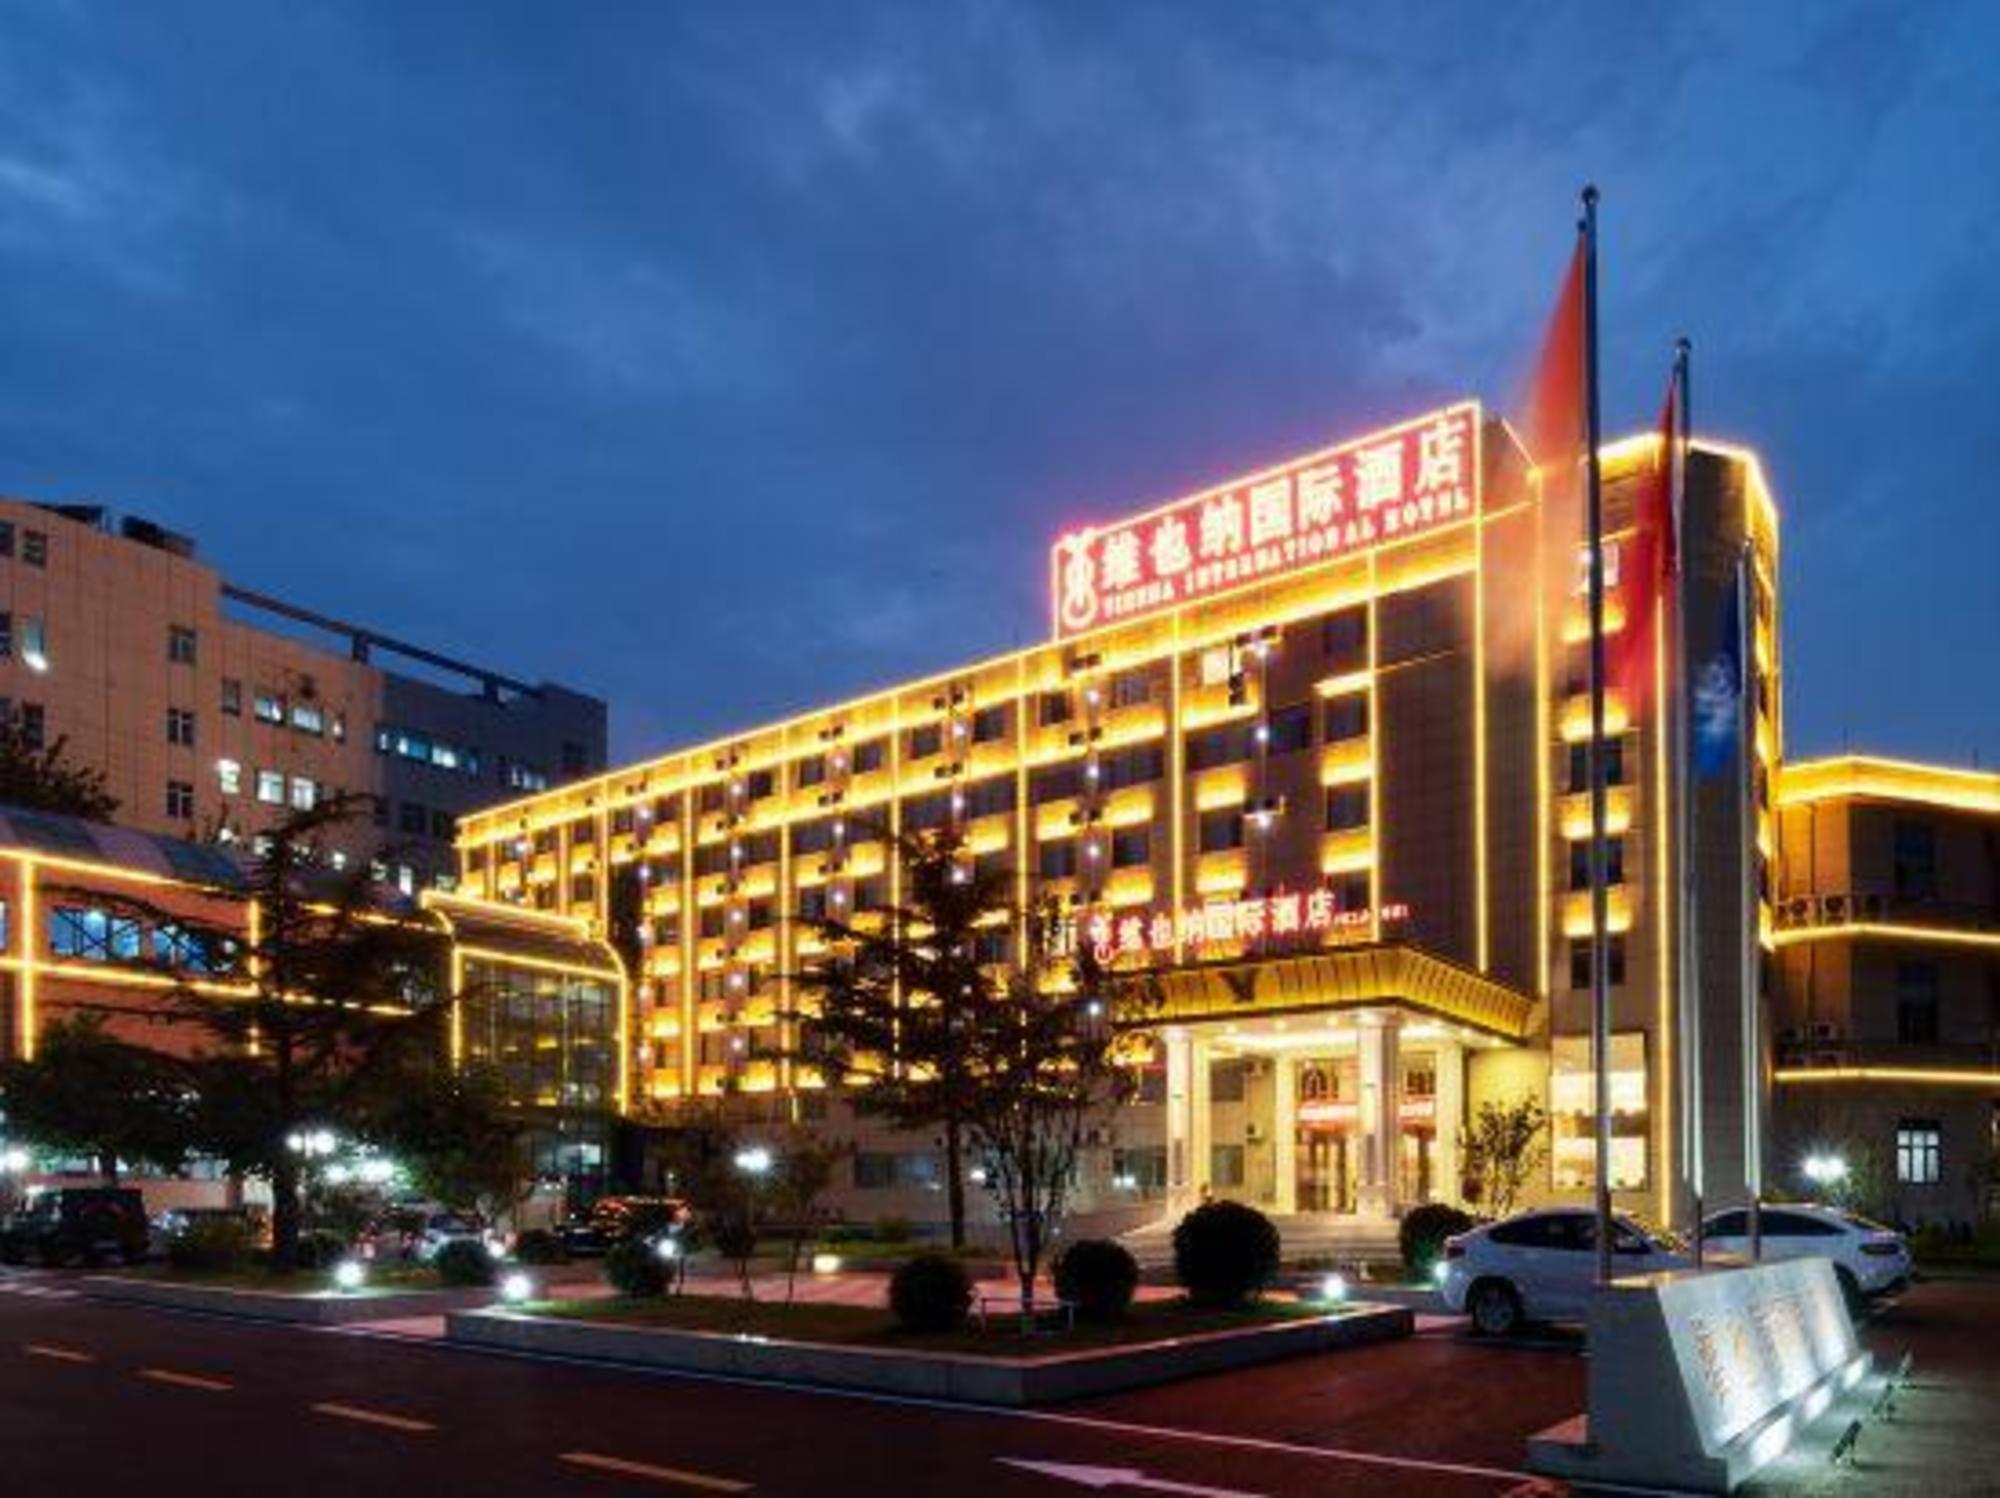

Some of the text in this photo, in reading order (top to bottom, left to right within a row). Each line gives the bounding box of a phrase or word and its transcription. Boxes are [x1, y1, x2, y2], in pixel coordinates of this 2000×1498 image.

[1101, 417, 1465, 590] 维也纳国际酒店
[1384, 486, 1469, 532] HOTEL
[1117, 888, 1336, 951] 维也纳国际酒店
